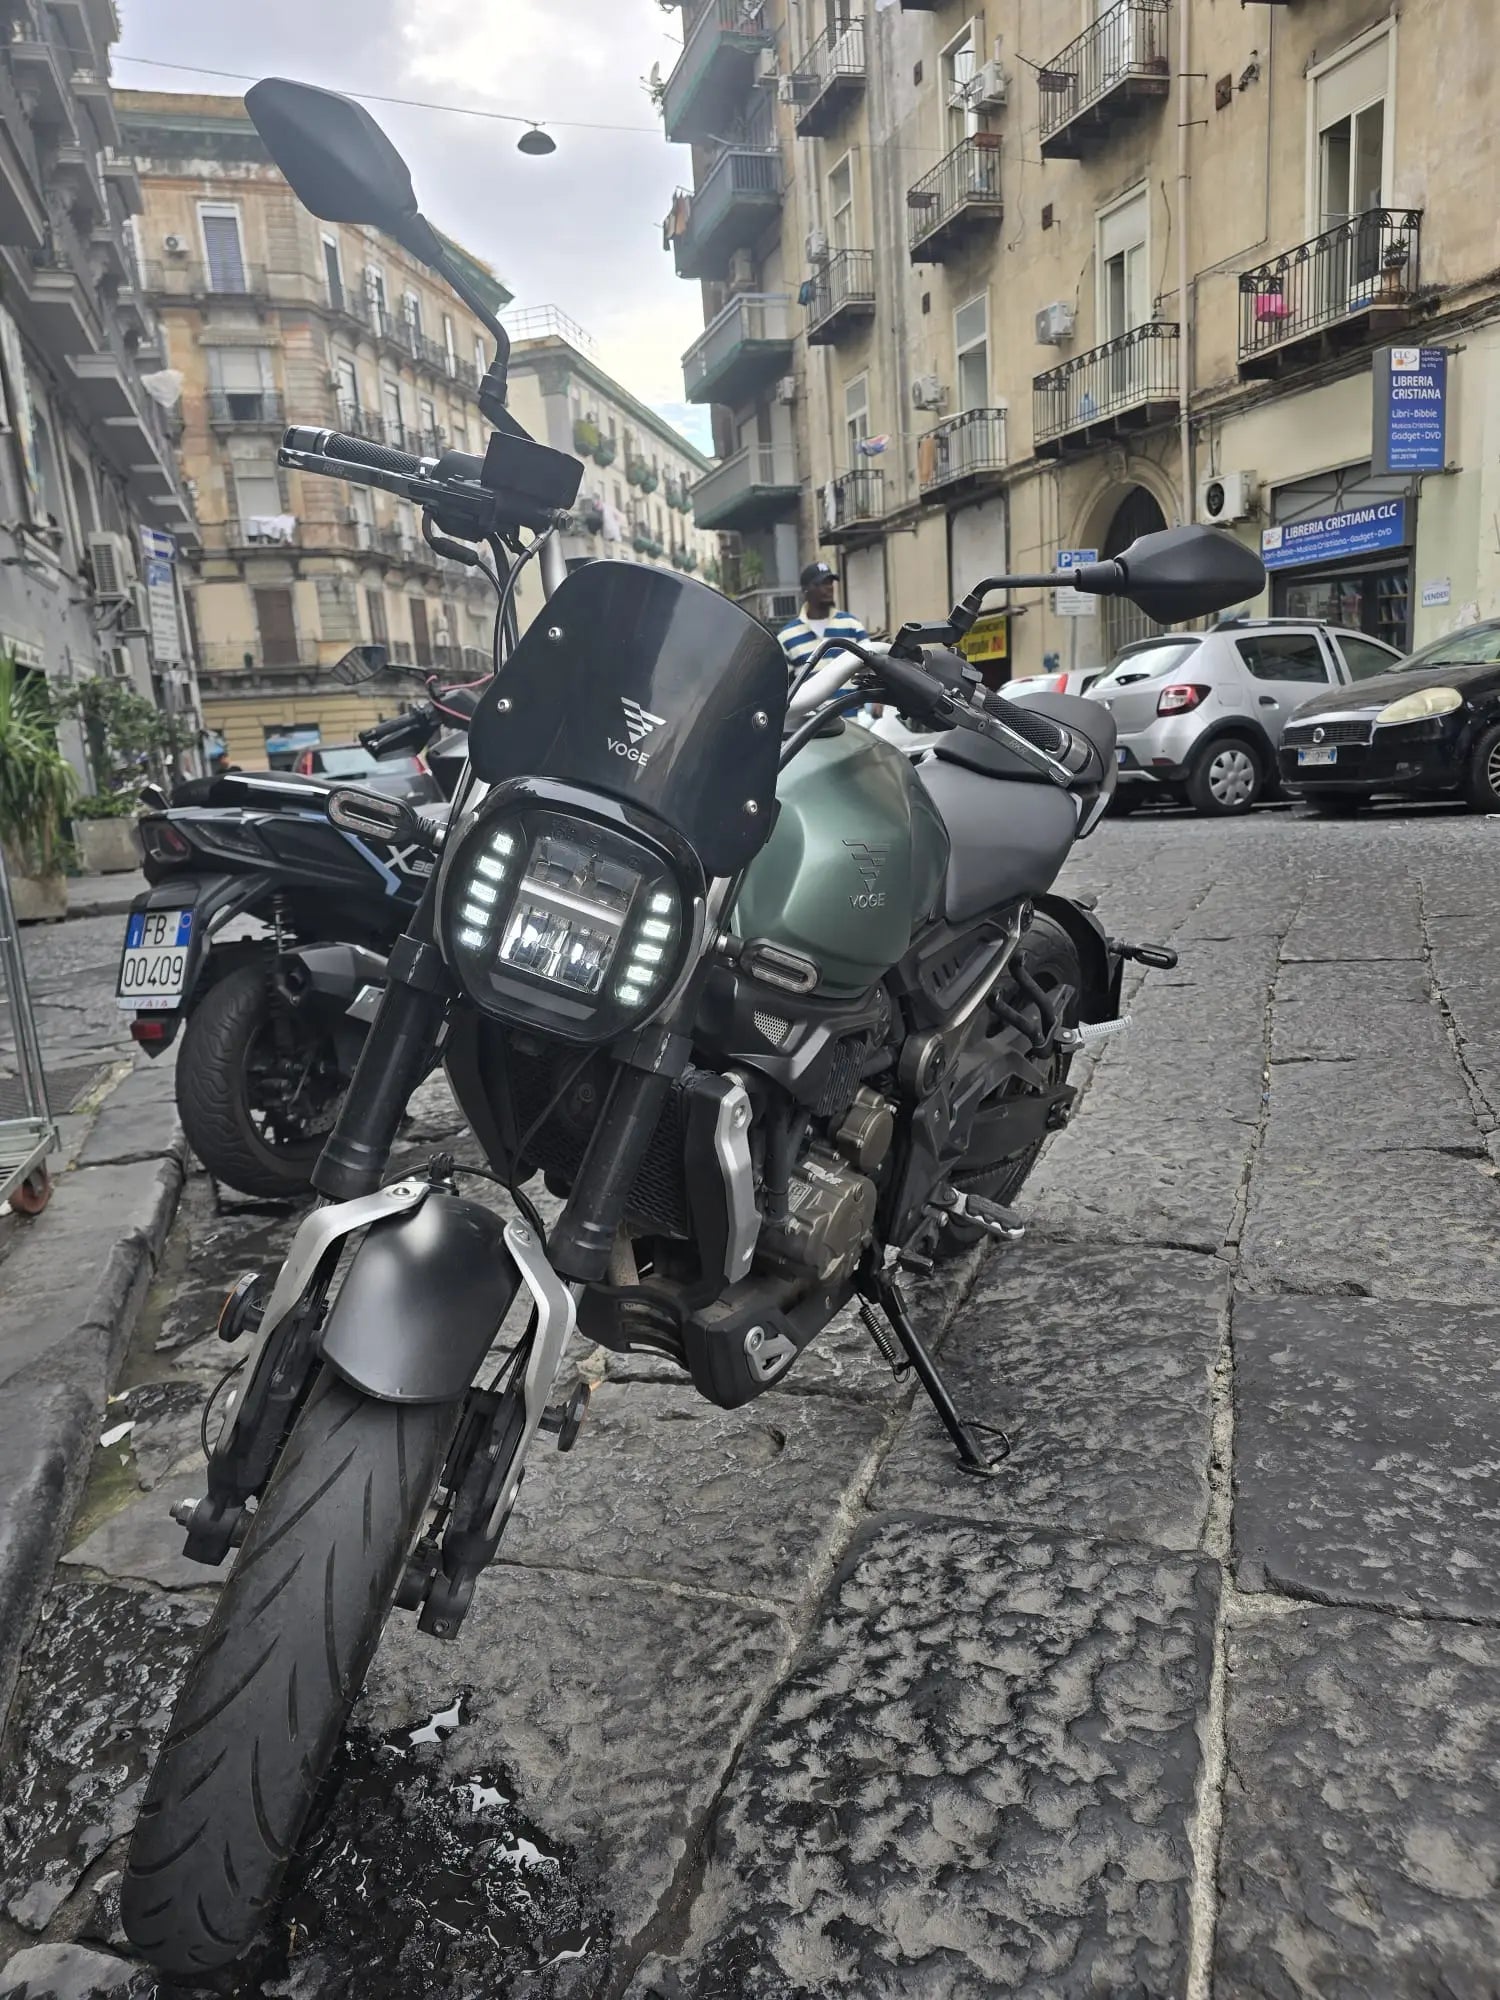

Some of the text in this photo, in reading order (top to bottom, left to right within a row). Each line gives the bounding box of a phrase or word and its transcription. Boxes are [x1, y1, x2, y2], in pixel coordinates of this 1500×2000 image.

[1392, 375, 1434, 387] LIBRERIA
[1392, 388, 1442, 400] CRISTIANA
[1285, 503, 1398, 540] LIBRERIA CRISTIANA CLC
[607, 736, 651, 767] VOGE
[848, 892, 886, 909] VOGE
[142, 914, 168, 947] FB
[123, 956, 184, 988] 00409
